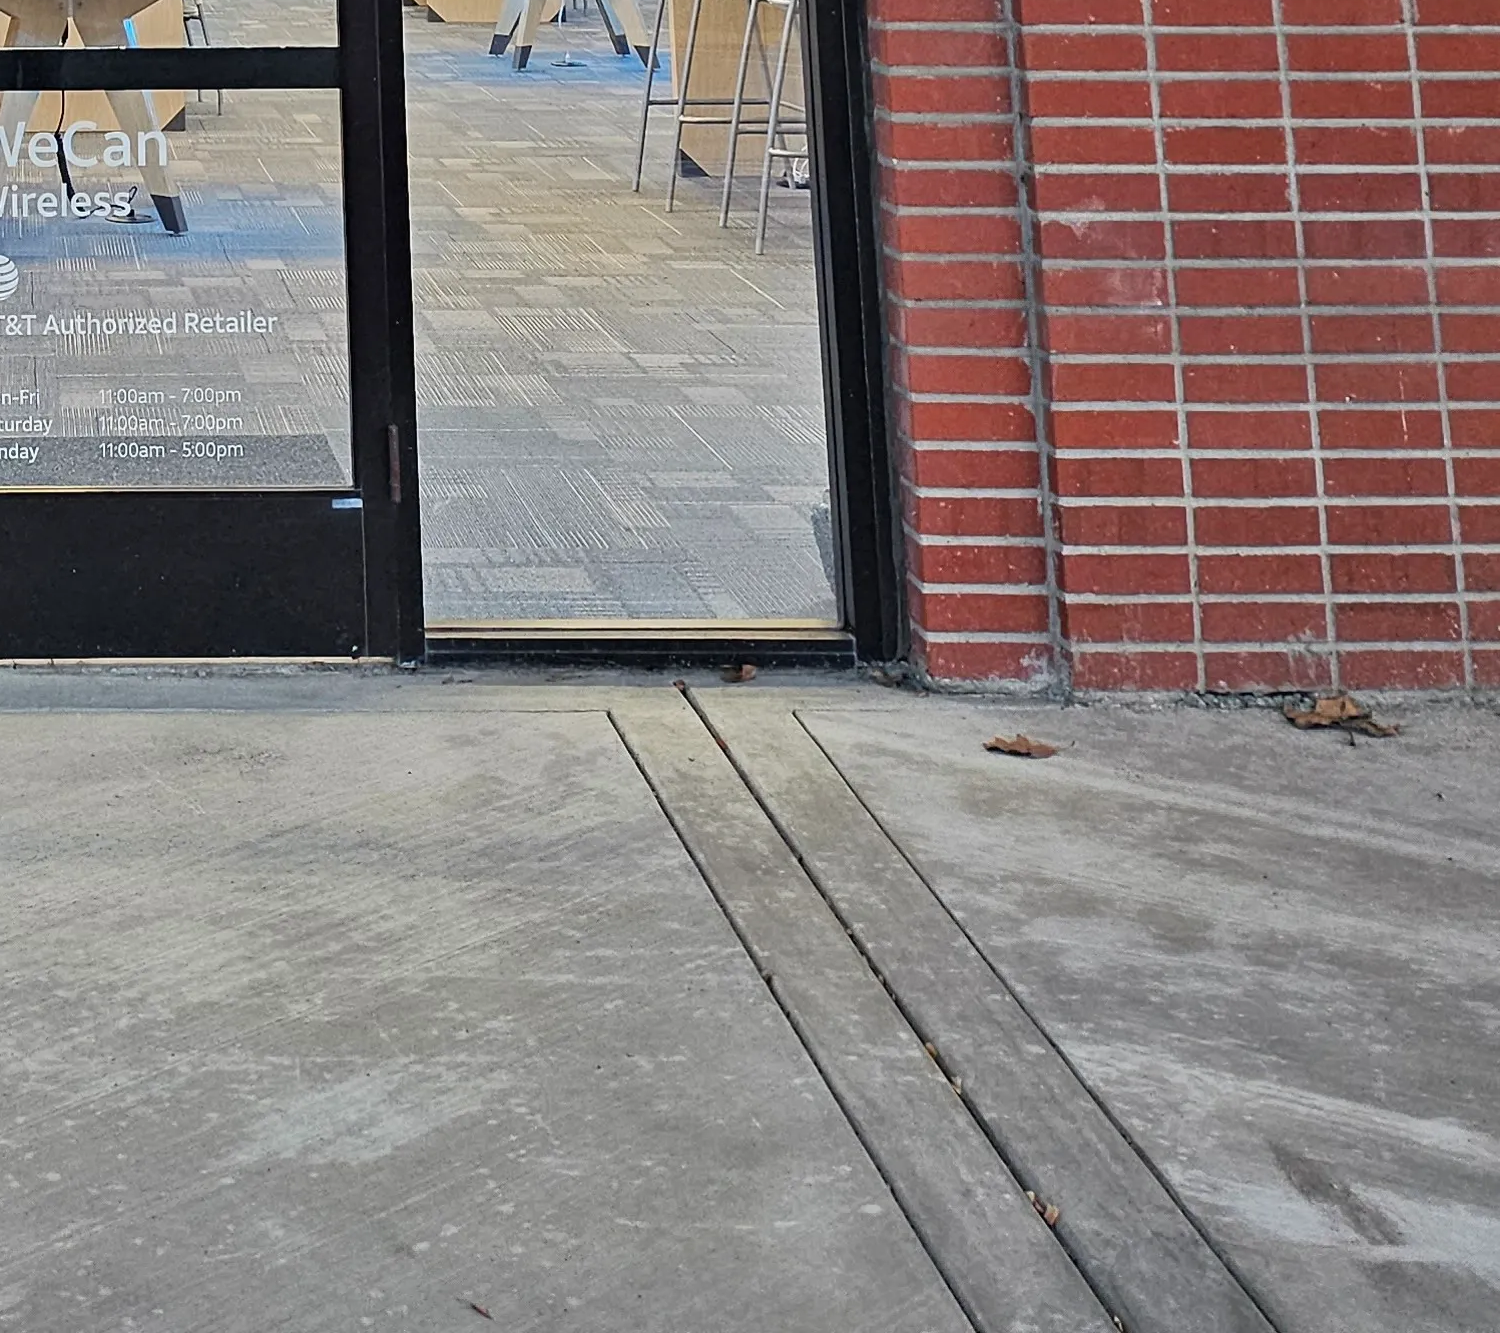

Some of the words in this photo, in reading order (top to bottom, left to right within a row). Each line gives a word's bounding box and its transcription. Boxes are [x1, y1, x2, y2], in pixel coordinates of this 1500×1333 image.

[42, 312, 177, 336] Authorized
[184, 310, 278, 334] Retailer
[99, 388, 165, 404] 11:00am
[181, 388, 242, 408] 7:00pm
[99, 416, 165, 431] 11:00am
[181, 415, 243, 435] 7:00pm
[99, 443, 165, 458] 11:00am
[182, 442, 244, 461] 5:00pm
